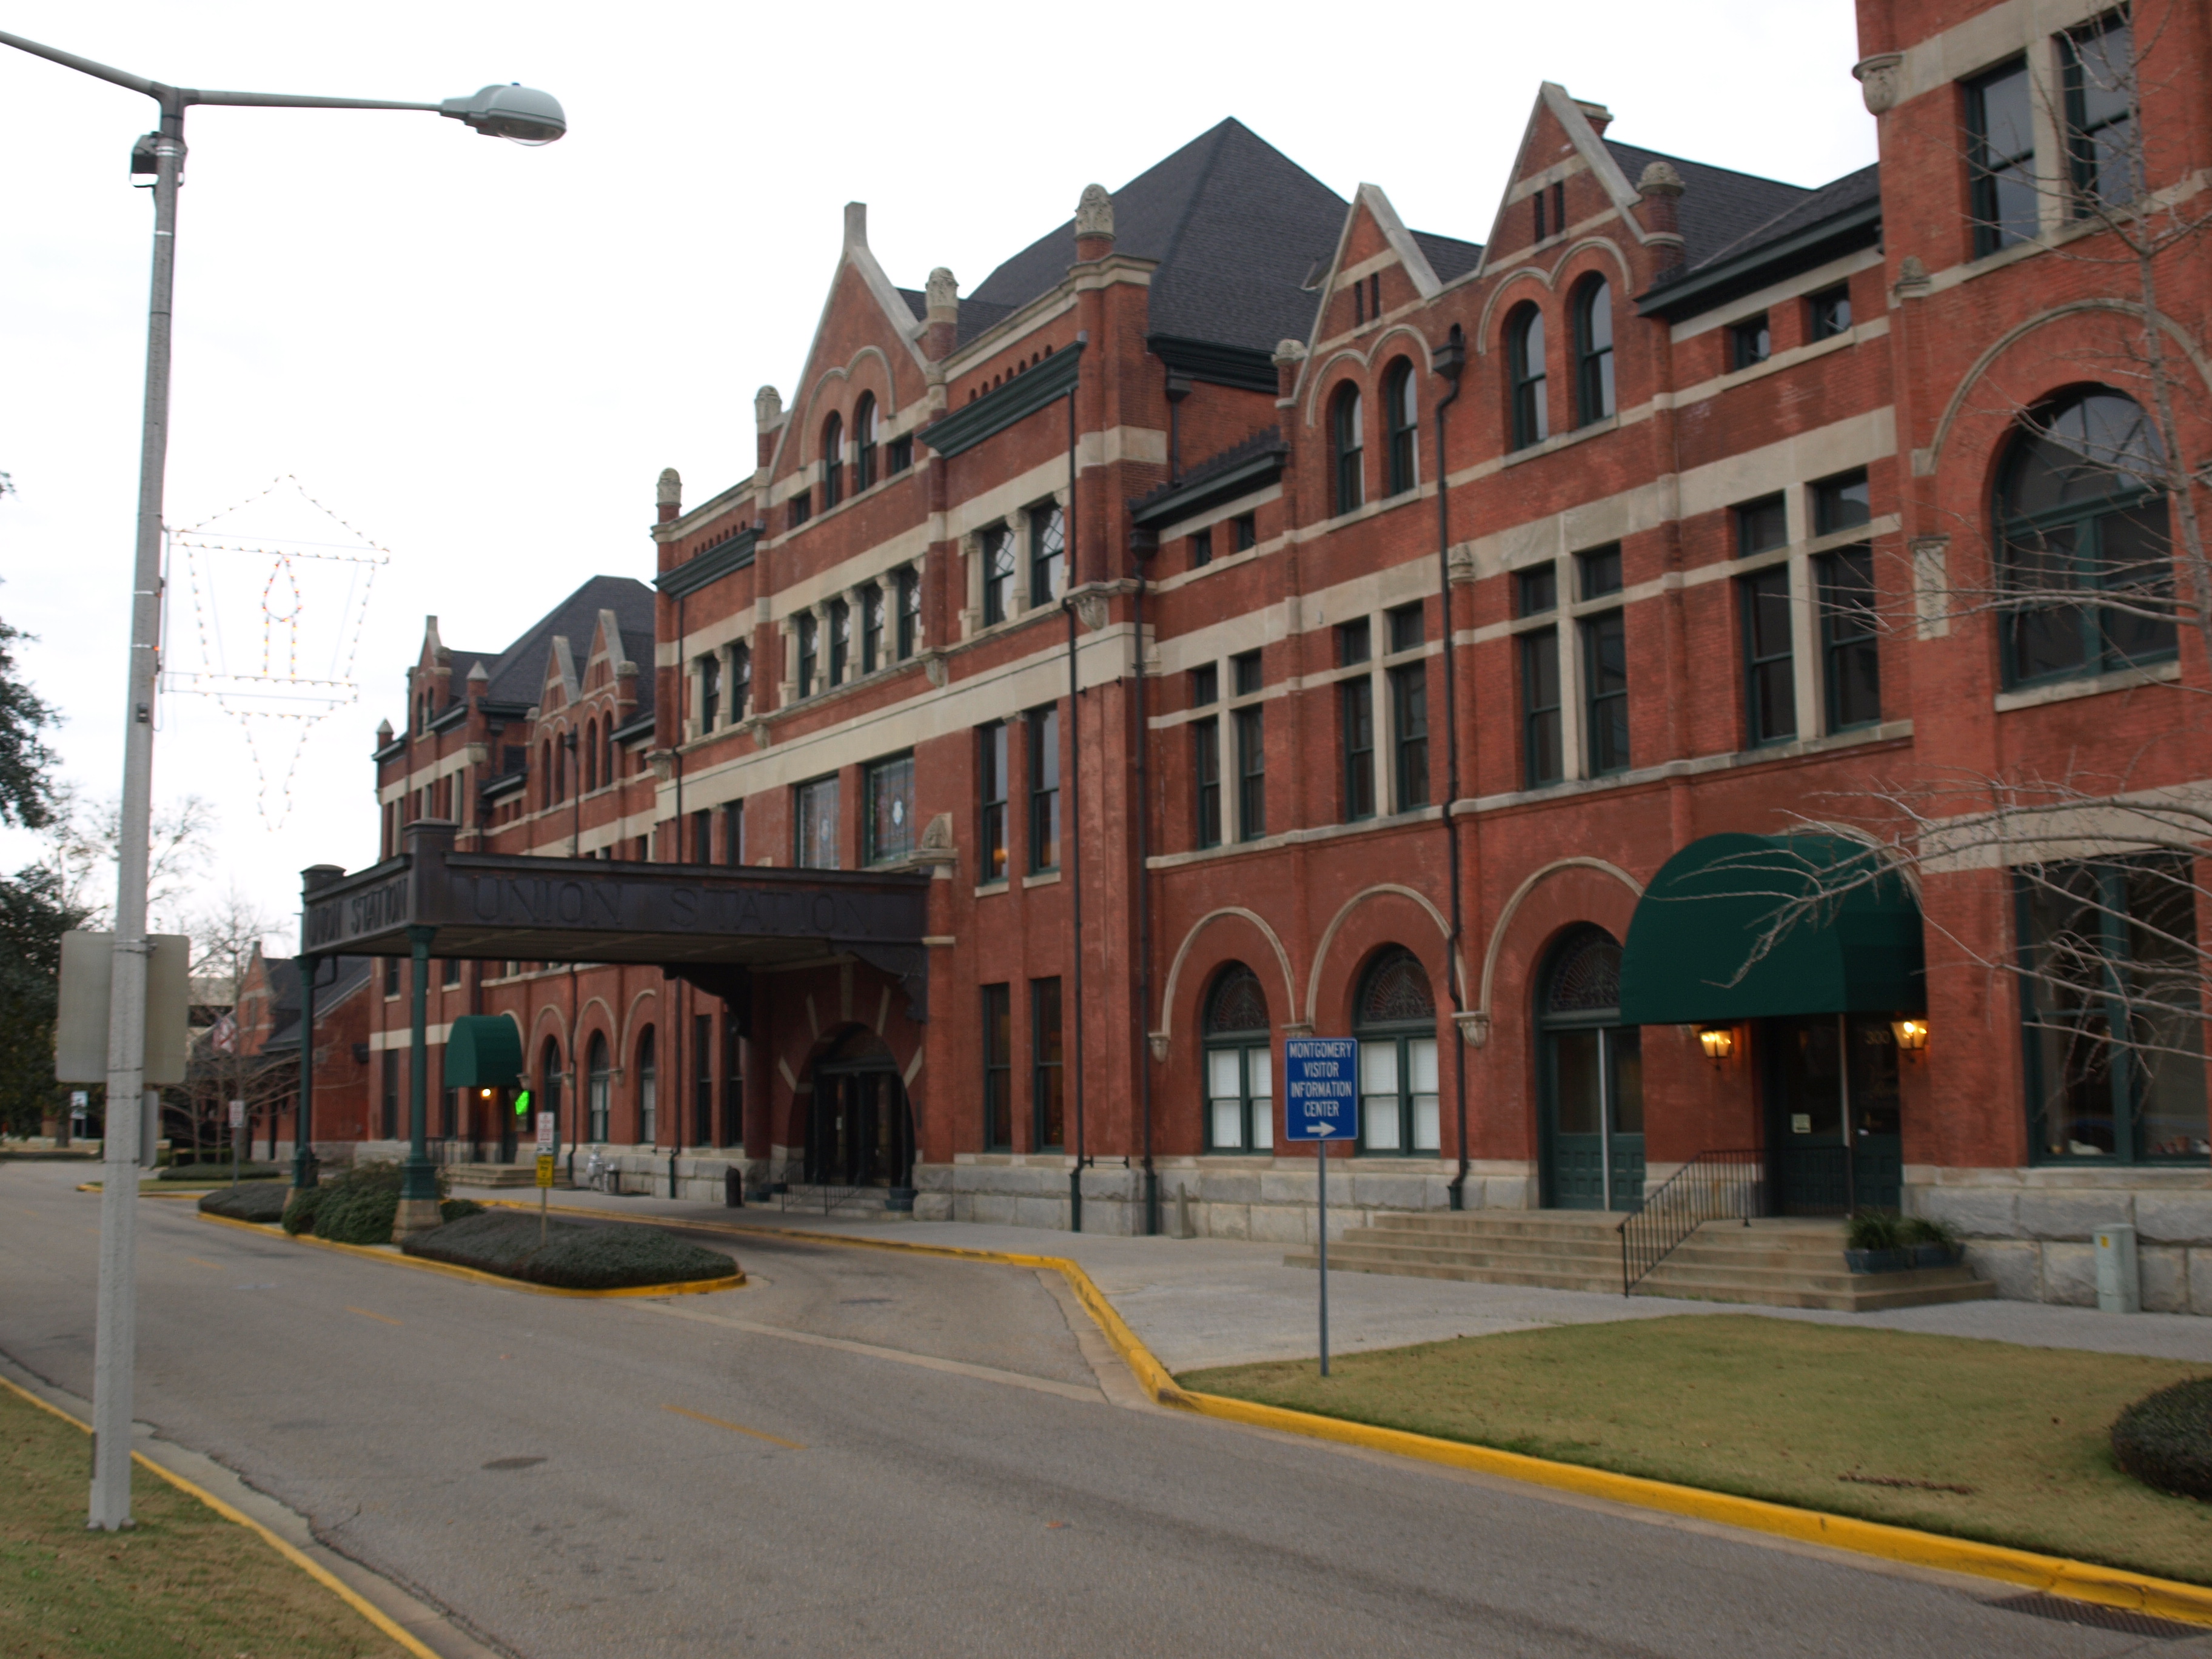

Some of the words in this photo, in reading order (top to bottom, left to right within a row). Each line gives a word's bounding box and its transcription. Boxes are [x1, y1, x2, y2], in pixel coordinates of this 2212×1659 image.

[471, 877, 623, 925] UNION
[669, 888, 871, 935] STATION
[1289, 1042, 1352, 1058] MONTGOMERY
[1303, 1062, 1339, 1078] VISITOR
[1291, 1082, 1352, 1098] INFORMATION
[1304, 1101, 1339, 1117] CENTER
